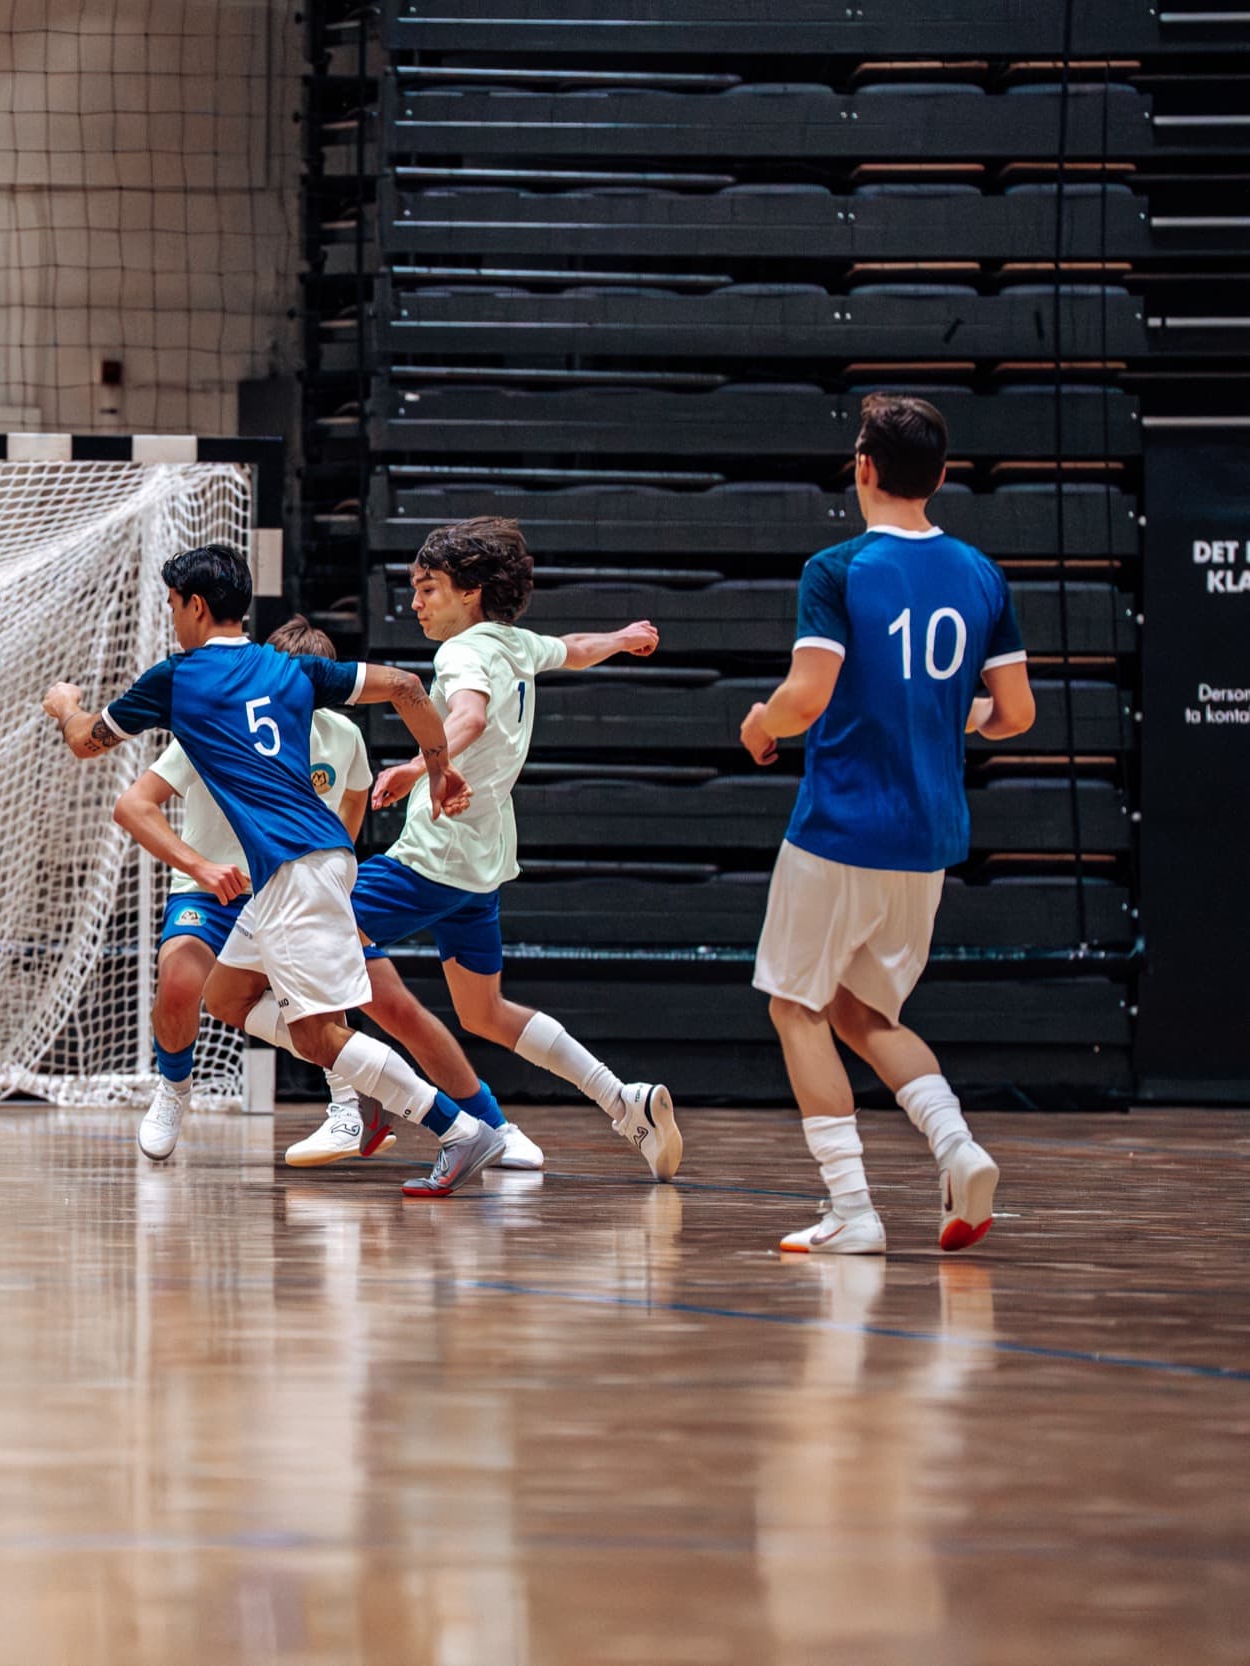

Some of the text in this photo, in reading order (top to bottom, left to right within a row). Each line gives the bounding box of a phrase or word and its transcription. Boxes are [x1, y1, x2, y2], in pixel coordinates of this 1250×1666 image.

[1193, 540, 1240, 563] DET
[888, 607, 967, 680] 10
[245, 695, 281, 757] 5
[1185, 703, 1250, 724] ta konta
